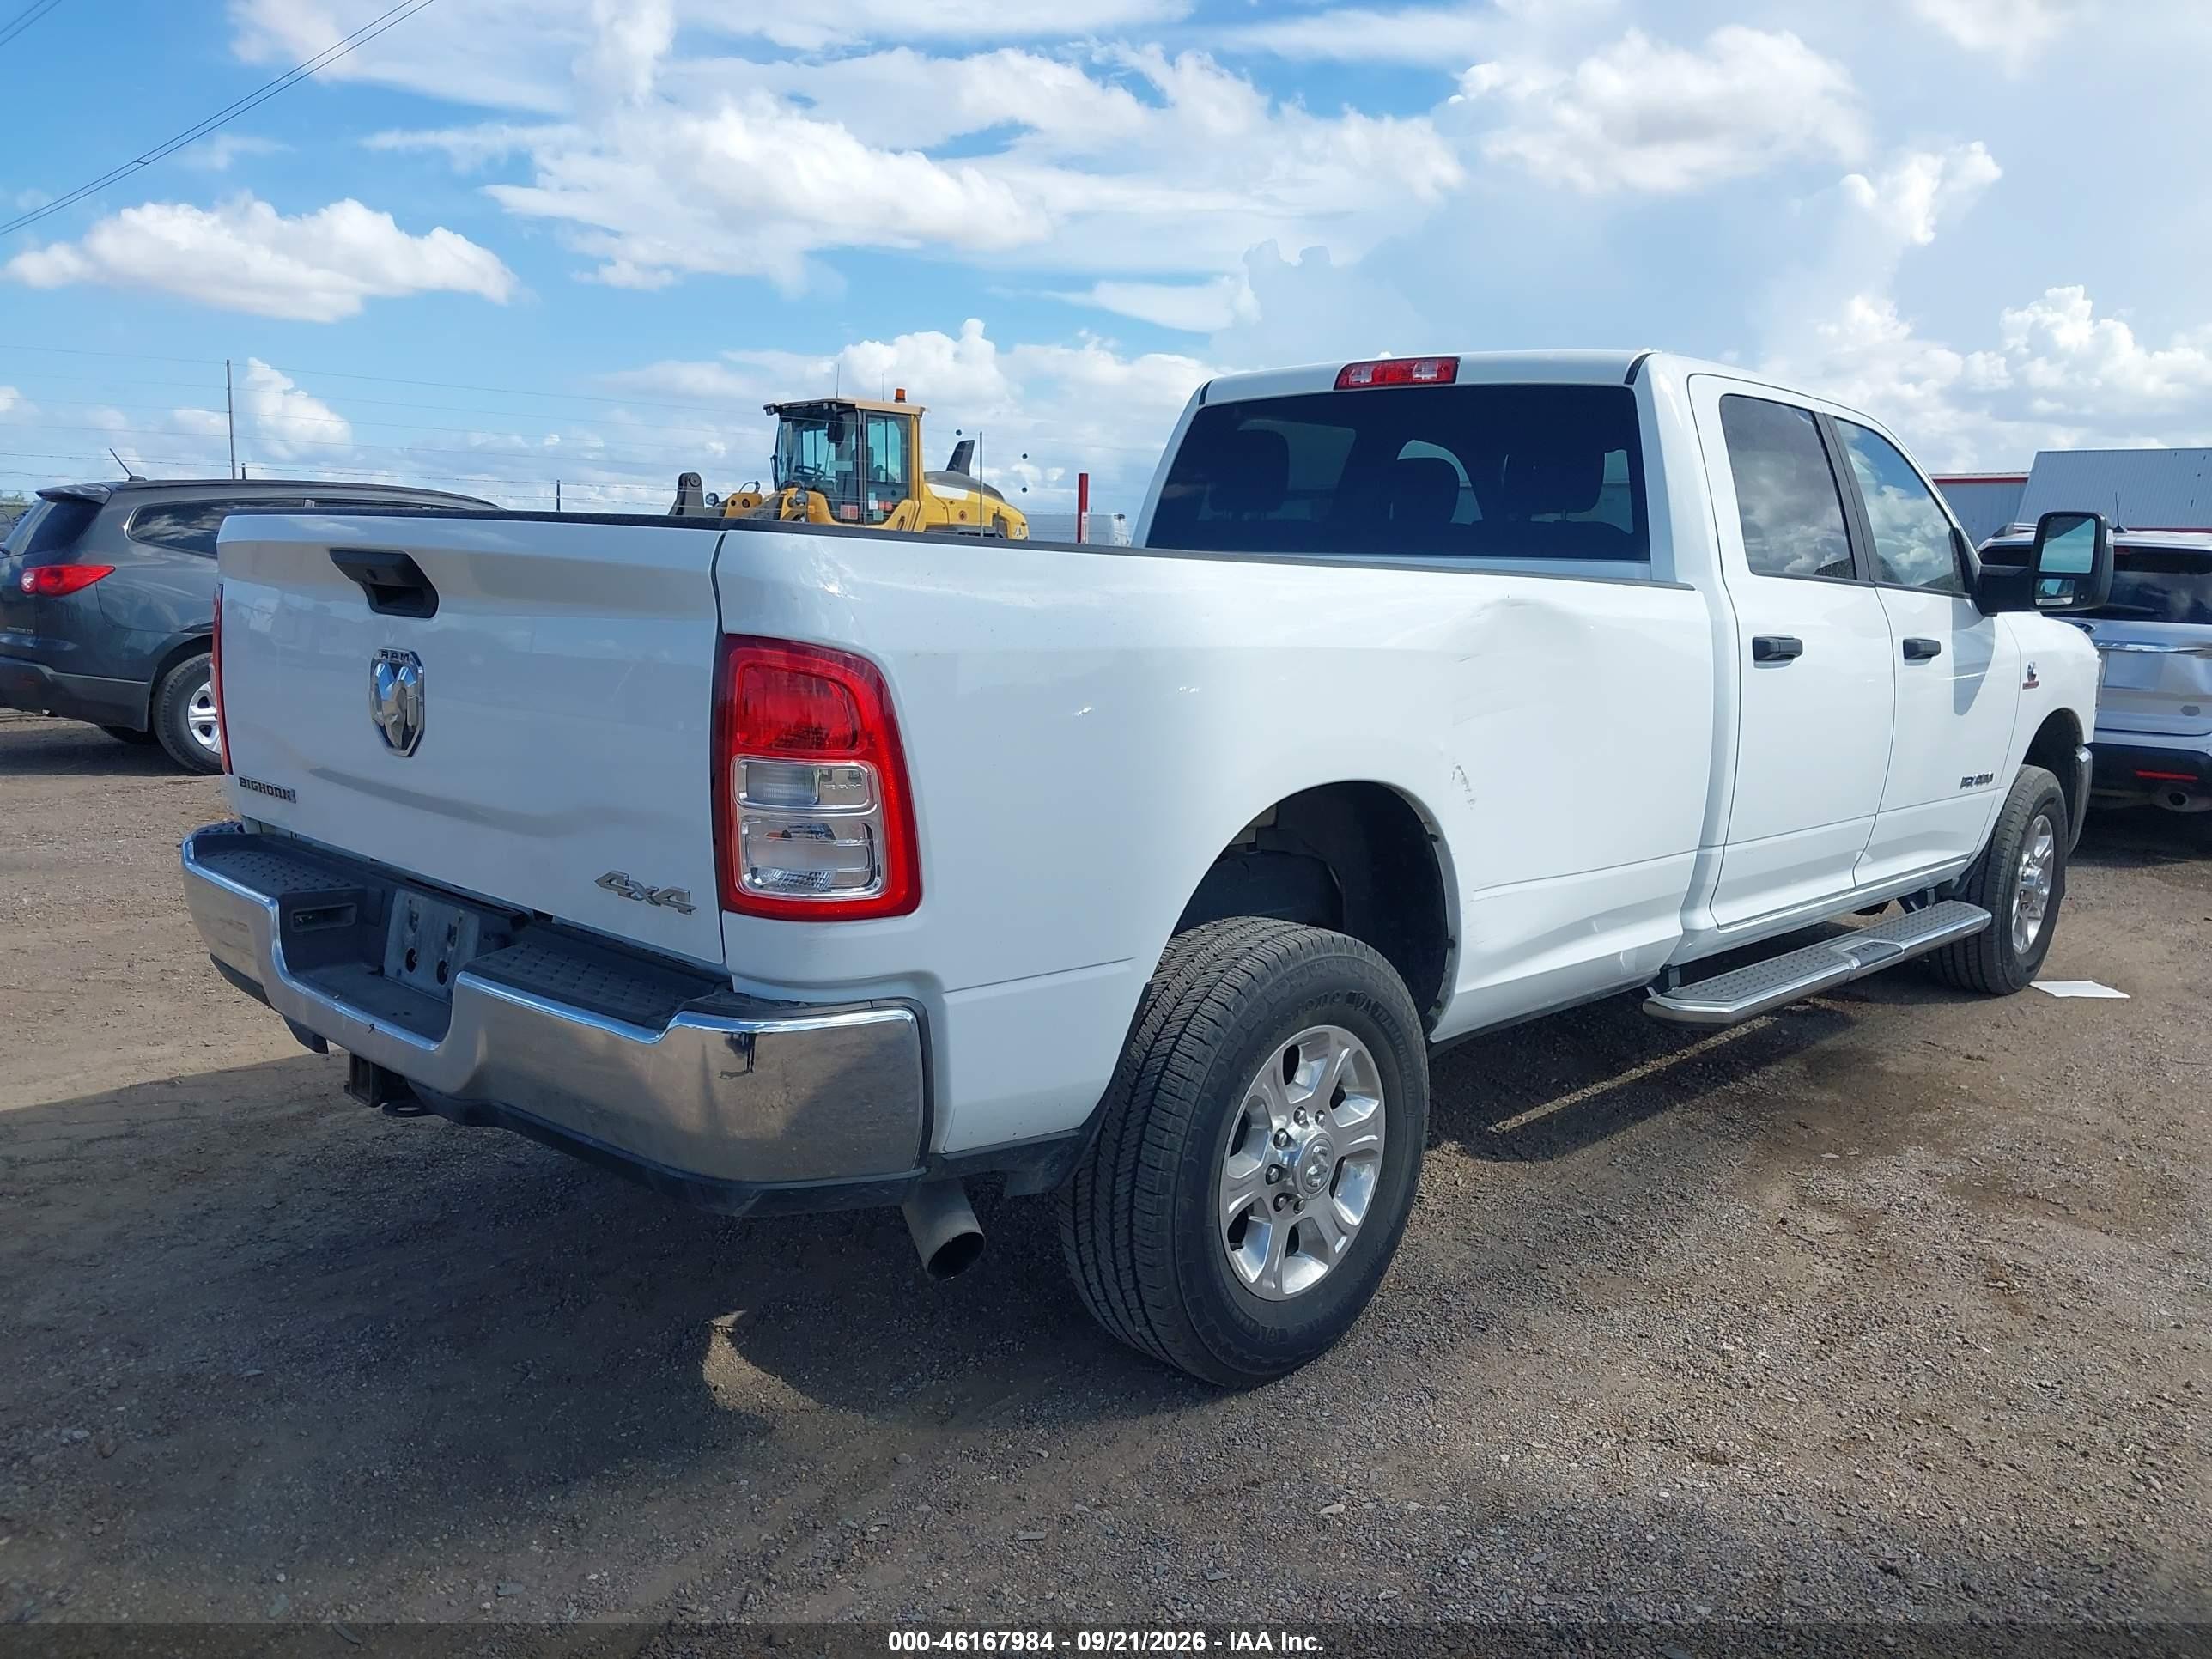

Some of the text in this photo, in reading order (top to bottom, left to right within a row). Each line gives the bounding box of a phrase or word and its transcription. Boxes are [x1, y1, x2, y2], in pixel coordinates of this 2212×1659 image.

[380, 650, 410, 662] RAM
[1960, 772, 1994, 789] RAM
[238, 776, 296, 804] BIGHORN
